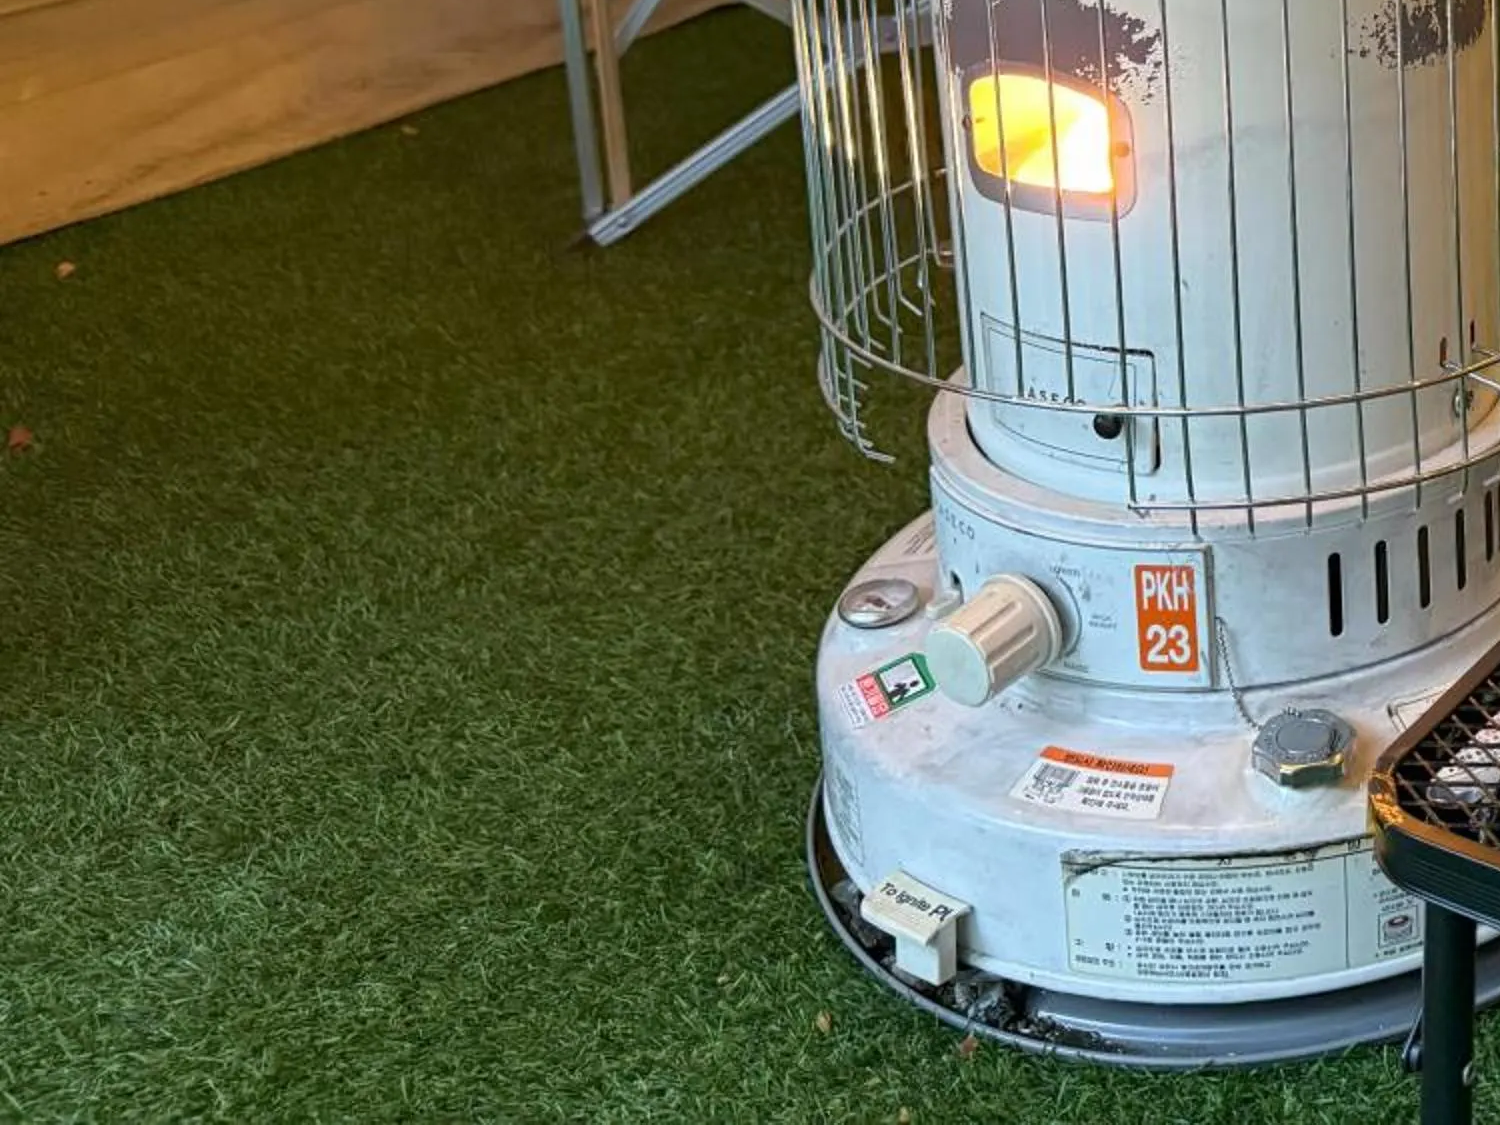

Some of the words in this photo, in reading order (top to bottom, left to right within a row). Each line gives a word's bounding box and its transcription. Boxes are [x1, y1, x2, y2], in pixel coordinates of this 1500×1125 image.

[1141, 570, 1189, 611] PKH
[1146, 624, 1191, 664] 23
[880, 882, 898, 896] To
